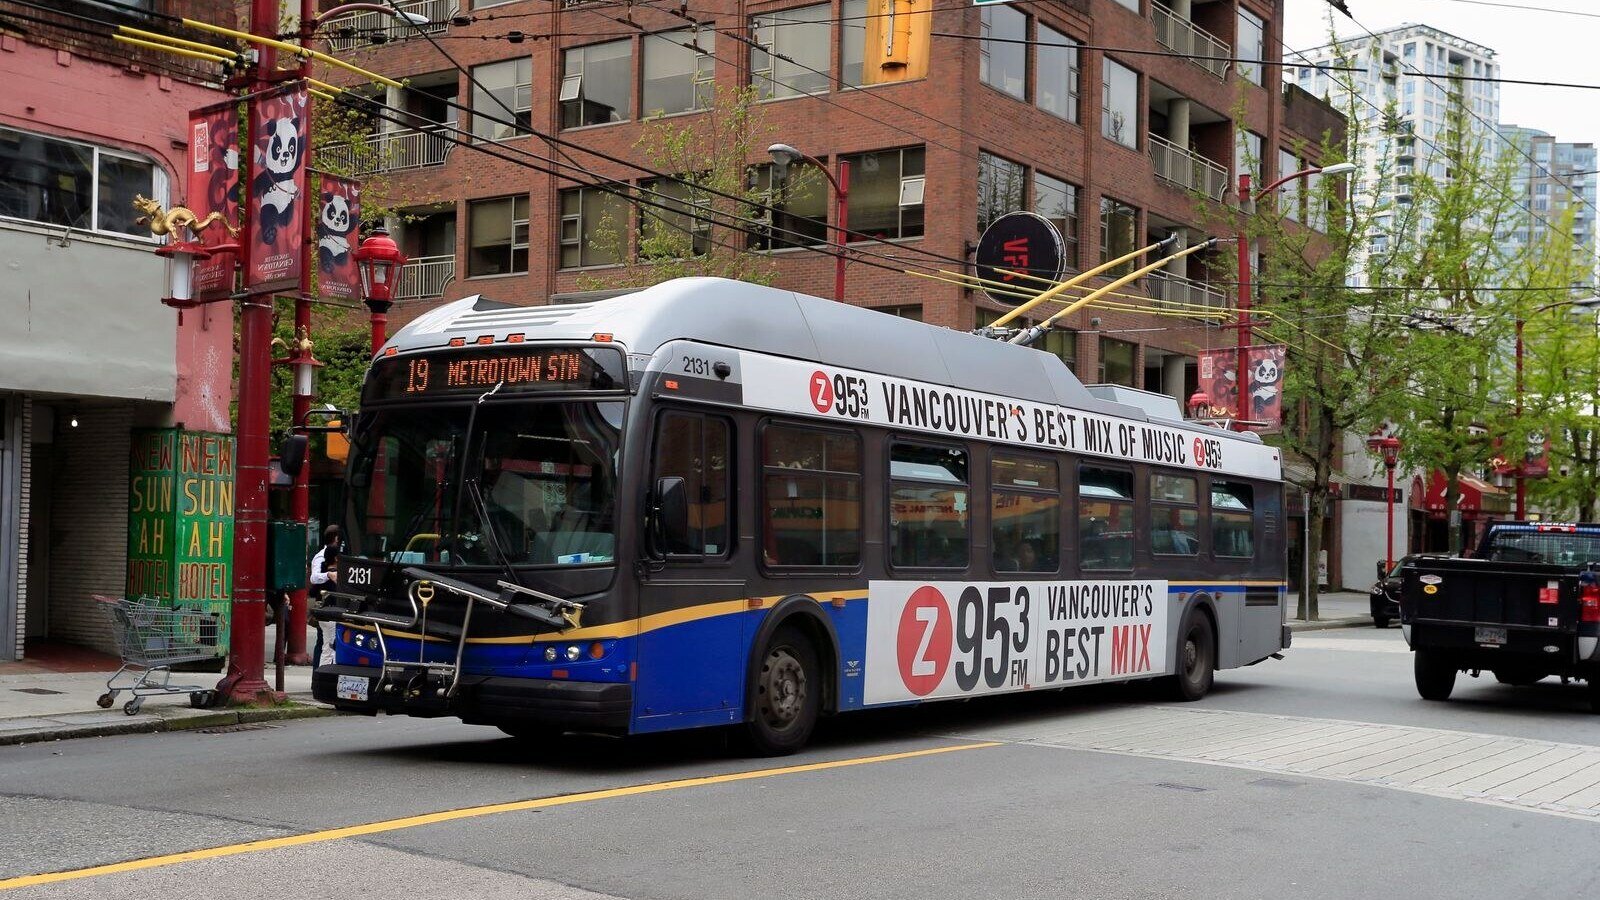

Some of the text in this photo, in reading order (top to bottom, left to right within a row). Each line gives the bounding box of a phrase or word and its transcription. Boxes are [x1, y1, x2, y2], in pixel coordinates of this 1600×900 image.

[407, 353, 580, 392] 19 METROTOWN STN
[683, 356, 709, 376] 2131
[861, 408, 870, 419] FM
[882, 382, 1028, 442] VANCOUVER'S
[1034, 408, 1076, 448] BEST
[1083, 418, 1113, 454] MIX
[1119, 424, 1136, 457] OF
[1142, 428, 1186, 464] MUSIC
[131, 434, 174, 471] NEW
[182, 435, 233, 475] NEW
[132, 476, 172, 513] SUN
[183, 479, 233, 516] SUN
[139, 518, 164, 555] AH
[188, 521, 224, 558] AH
[129, 559, 171, 598] HOTEL
[179, 562, 229, 600] HOTEL
[348, 567, 371, 585] 2131
[1048, 585, 1153, 620] VANCOUVER'S
[912, 606, 939, 677] Z
[1045, 623, 1152, 682] BEST MIX
[1011, 659, 1028, 686] FM
